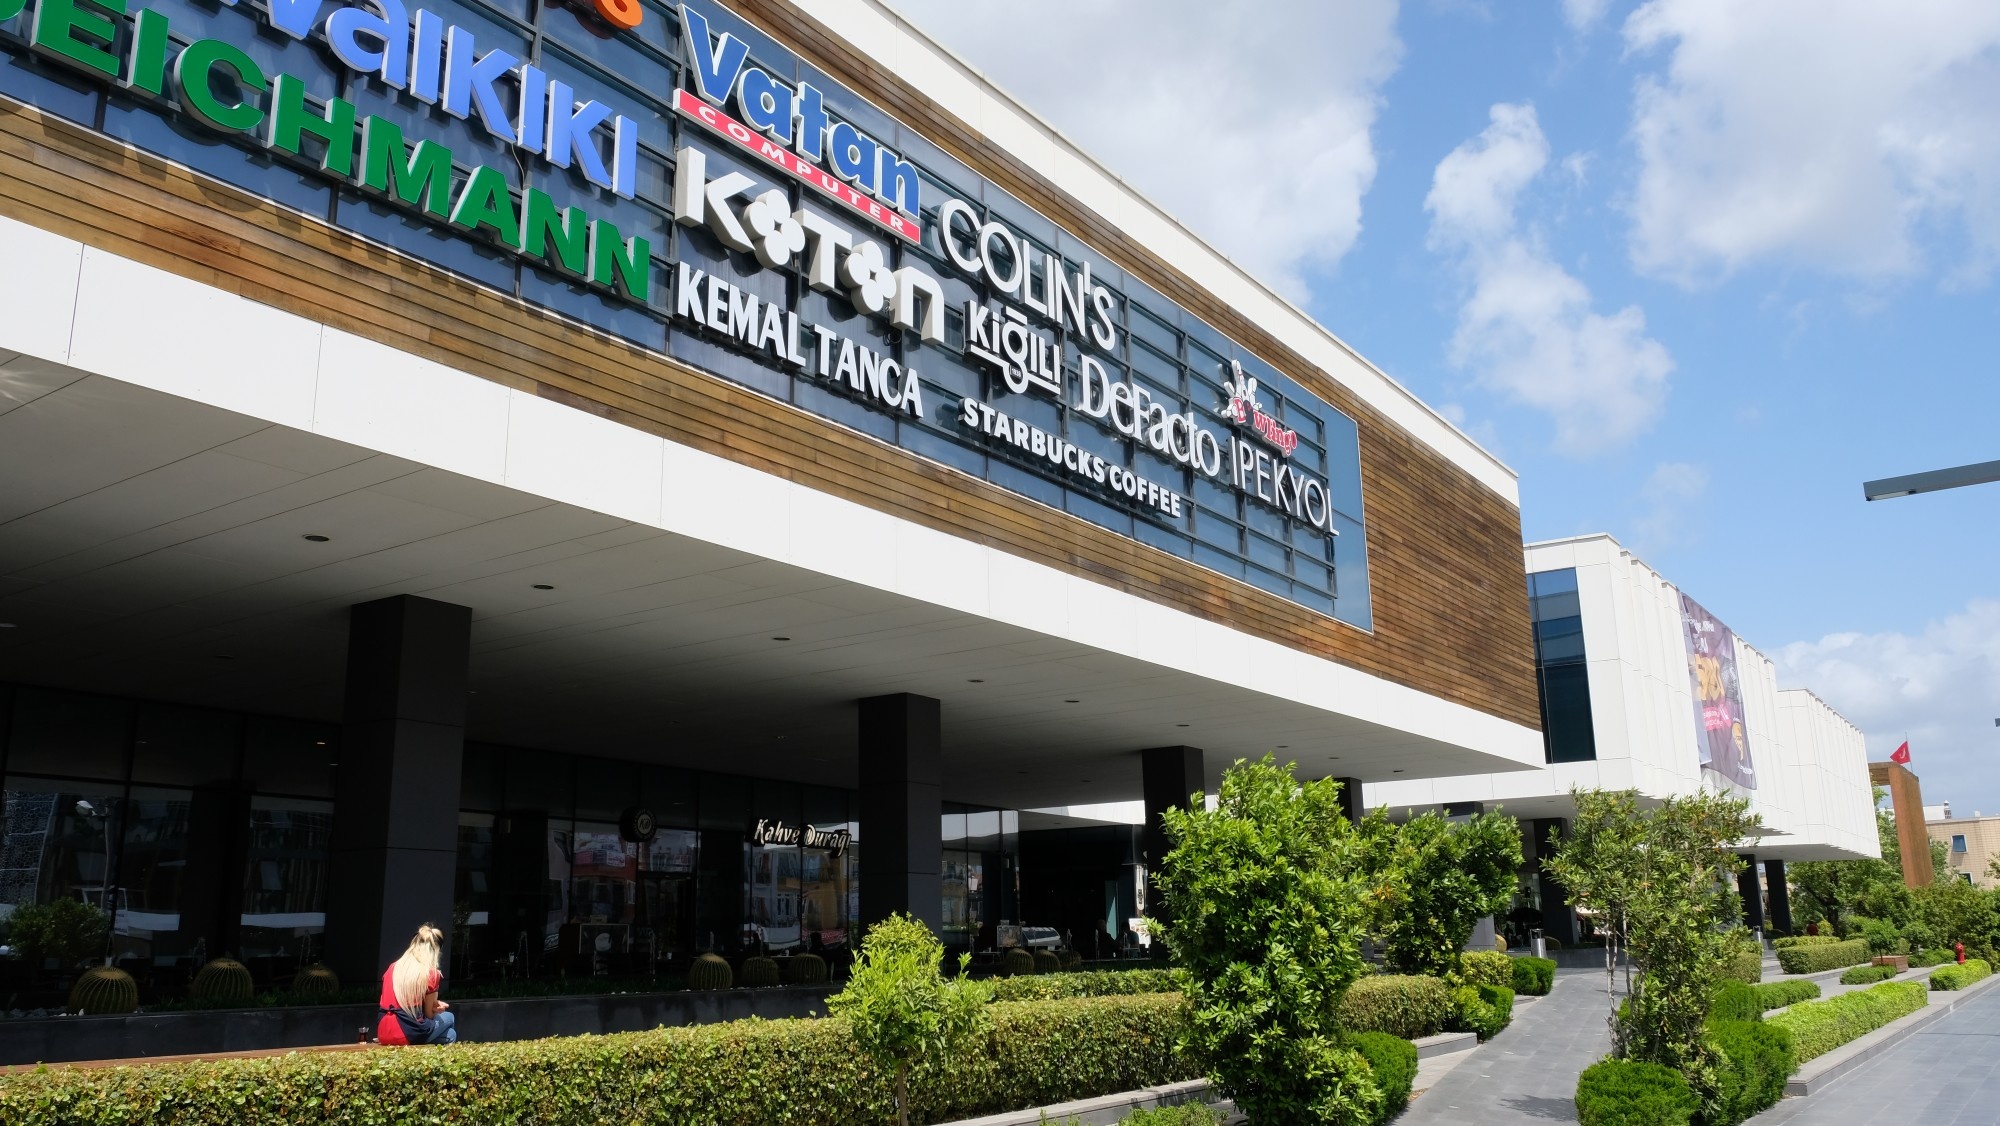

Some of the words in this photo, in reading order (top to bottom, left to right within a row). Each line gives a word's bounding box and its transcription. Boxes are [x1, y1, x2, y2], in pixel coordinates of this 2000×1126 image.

[0, 0, 650, 301] EICHMANN
[677, 3, 921, 219] Vatan
[698, 105, 905, 233] COMPUTER
[938, 199, 1115, 351] COLIN'S
[674, 261, 806, 367] KEMAL
[809, 323, 924, 418] TANCA
[960, 397, 1105, 483] STARBUCKS
[1107, 464, 1181, 518] COFFEE
[1077, 354, 1220, 477] DeFacto
[1230, 435, 1340, 537] IPEKYOL
[753, 817, 800, 845] Kahve
